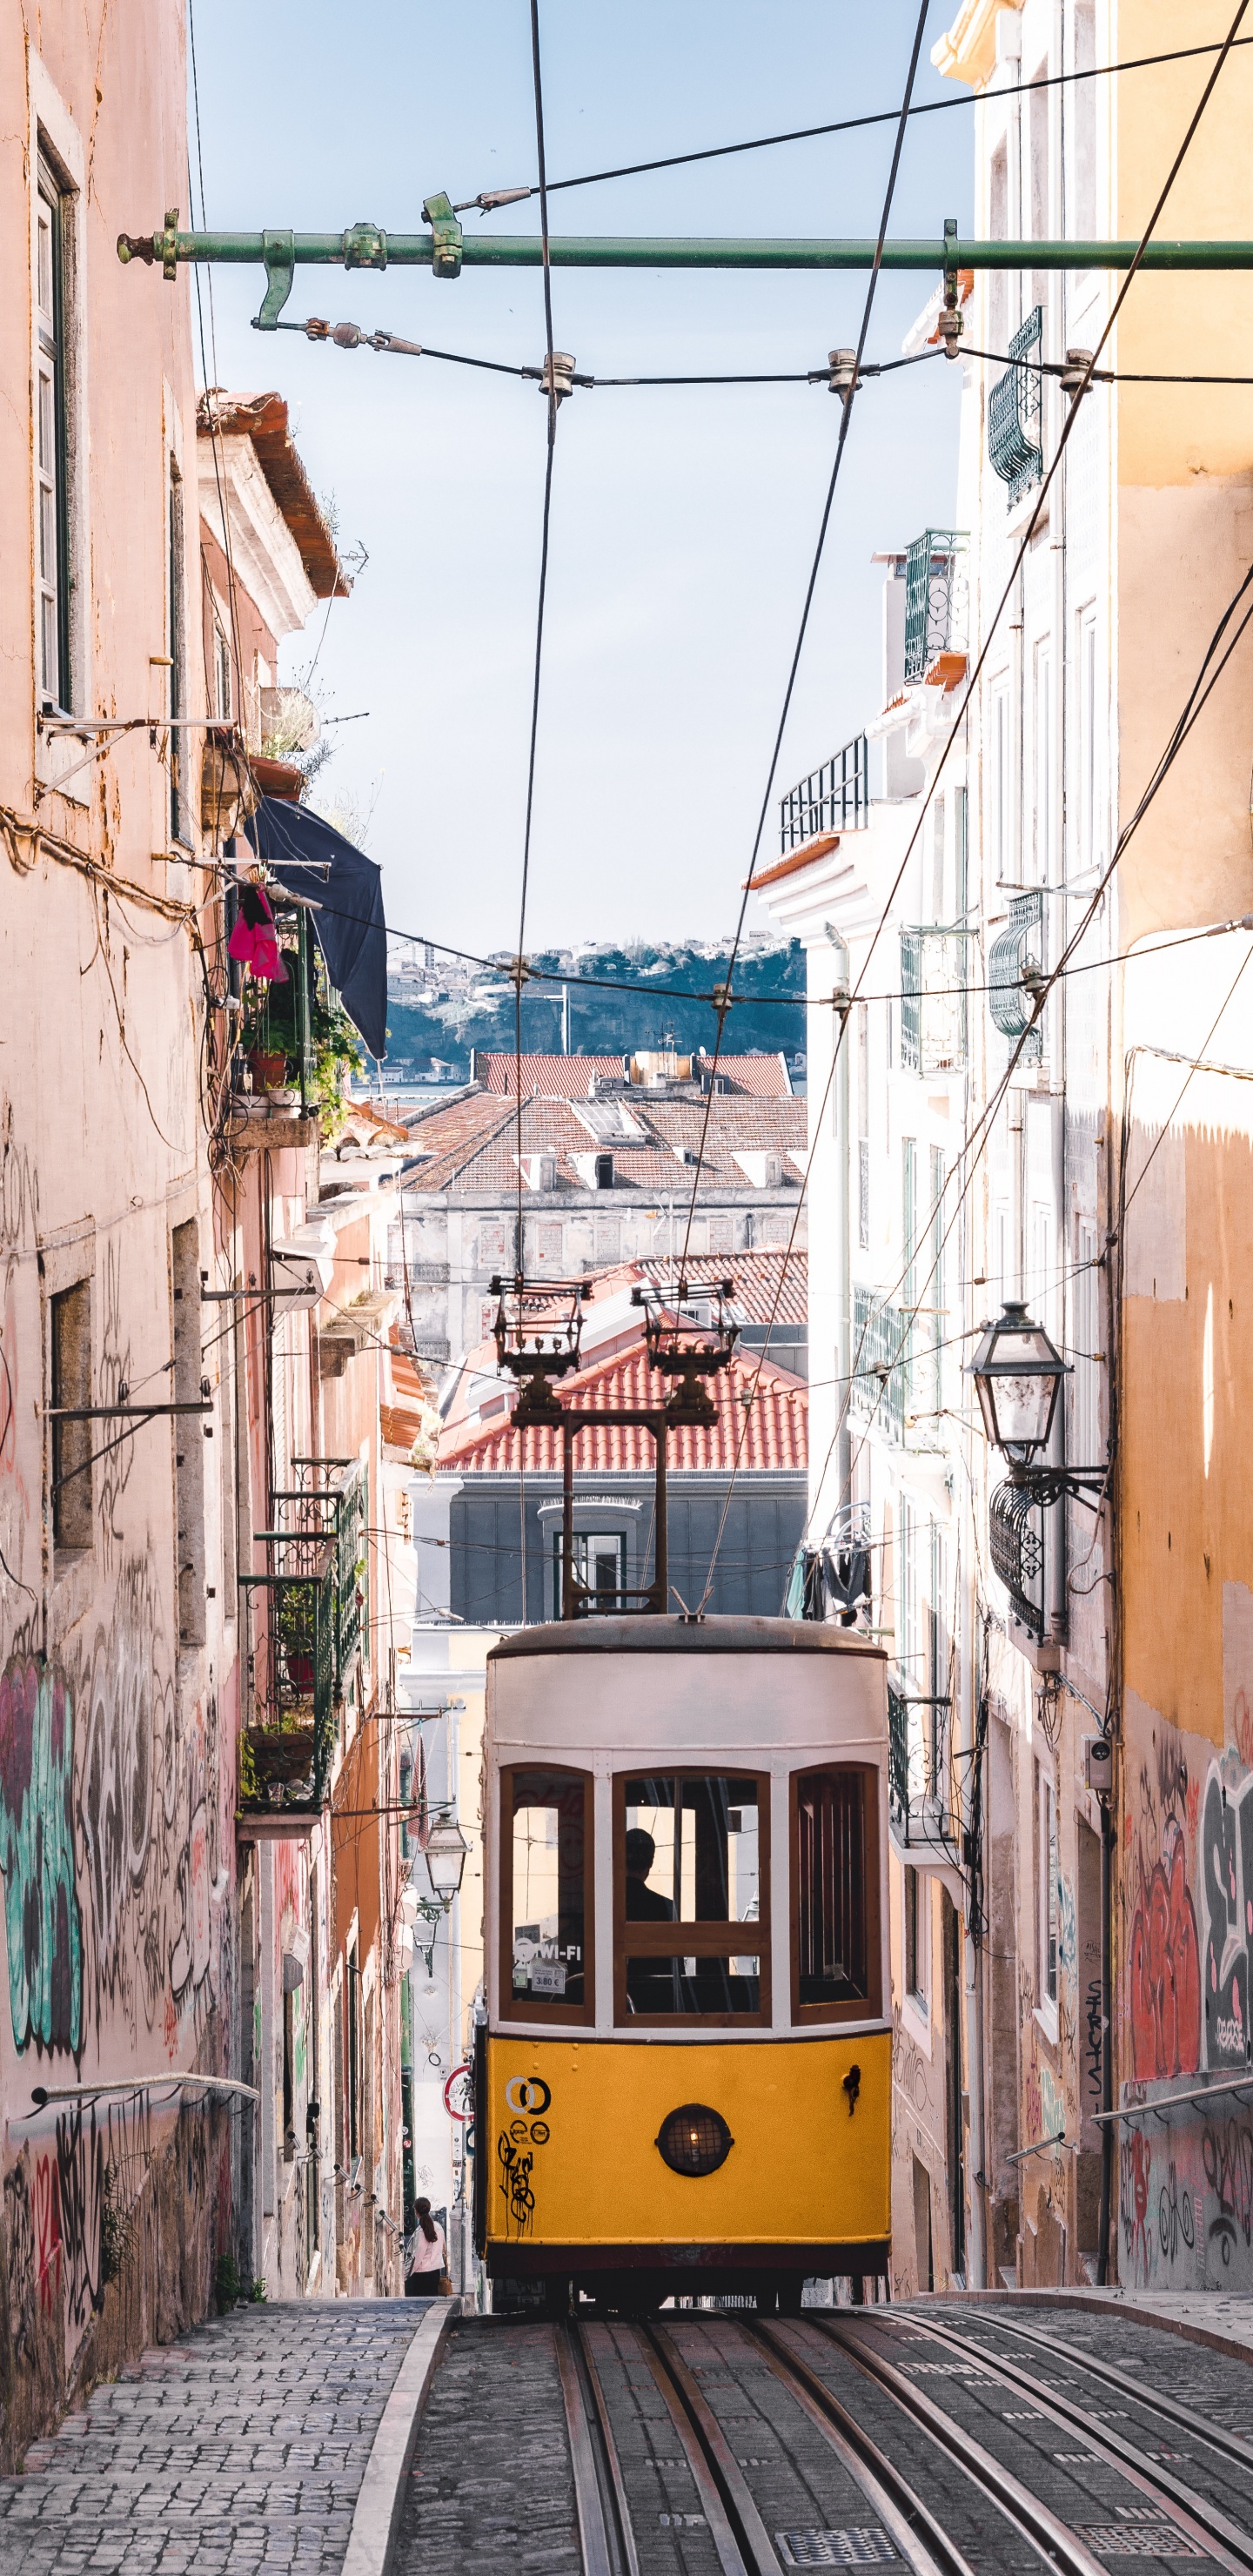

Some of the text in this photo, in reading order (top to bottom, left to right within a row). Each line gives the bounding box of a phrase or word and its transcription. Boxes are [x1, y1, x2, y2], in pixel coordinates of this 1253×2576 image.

[540, 1943, 581, 1961] WI-FI
[536, 1976, 559, 1987] 3.80 €
